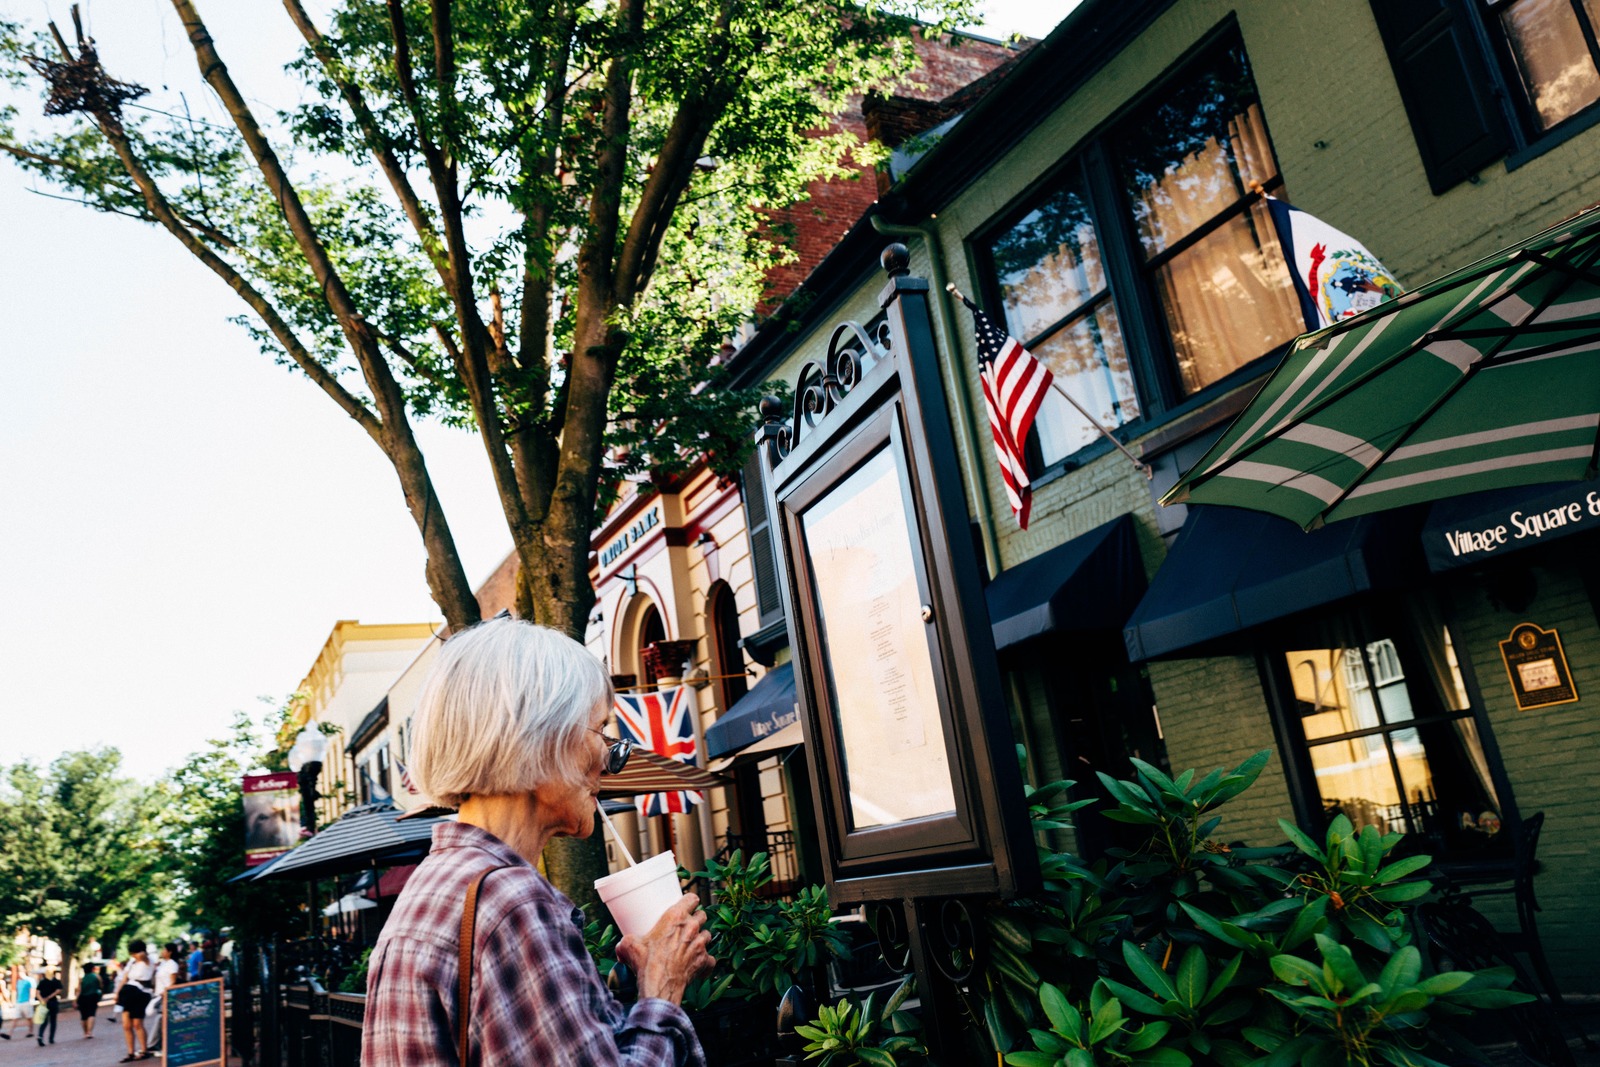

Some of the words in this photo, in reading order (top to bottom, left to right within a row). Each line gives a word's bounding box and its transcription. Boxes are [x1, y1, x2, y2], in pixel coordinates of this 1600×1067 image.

[630, 506, 660, 544] BANK
[1445, 525, 1508, 556] Village
[1510, 502, 1582, 539] Square
